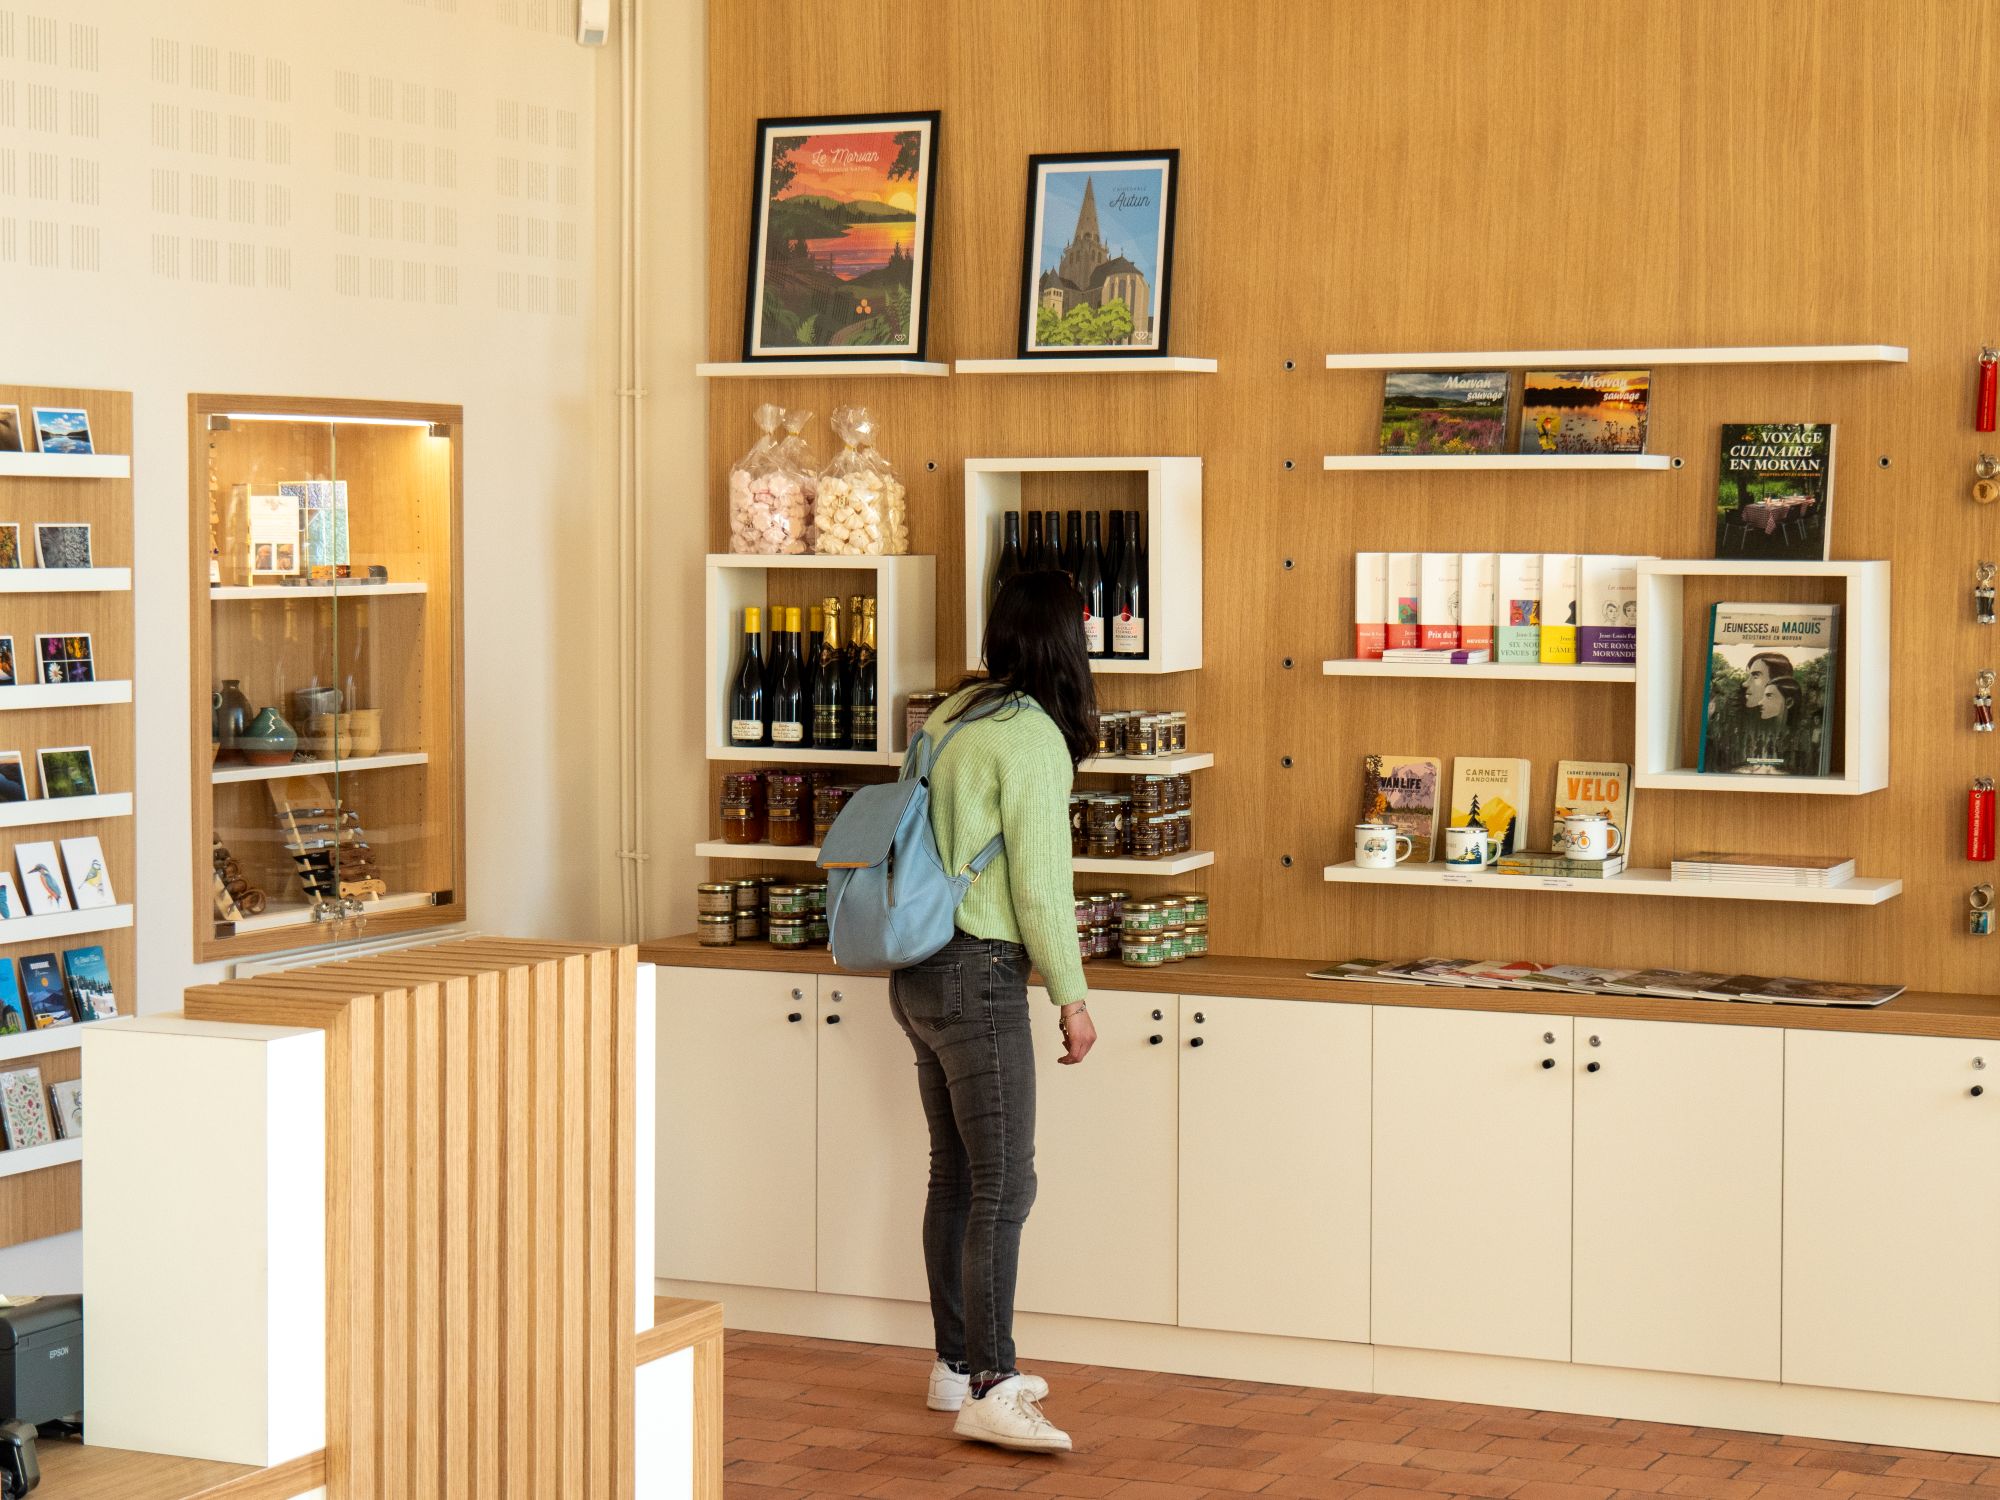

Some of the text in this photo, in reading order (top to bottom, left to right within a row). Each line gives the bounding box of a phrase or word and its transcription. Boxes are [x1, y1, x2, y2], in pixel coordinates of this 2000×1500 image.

[812, 148, 879, 168] Le Morvan
[1109, 192, 1150, 211] Autun
[1444, 376, 1491, 389] Morvan
[1581, 375, 1628, 388] Morvan
[1467, 391, 1502, 401] sauvage
[1603, 392, 1640, 402] sauvage
[1761, 432, 1822, 444] VOYAGE
[1730, 446, 1813, 457] CULINAIRE
[1730, 459, 1821, 471] EN MORVAN
[1722, 623, 1769, 633] JEUNESSES
[1782, 622, 1821, 634] MAQUIS
[1428, 631, 1441, 639] Prix
[1443, 631, 1452, 639] du
[1380, 777, 1421, 789] VAN LIFE
[1567, 777, 1620, 802] VELO
[49, 1346, 69, 1359] EPSON
